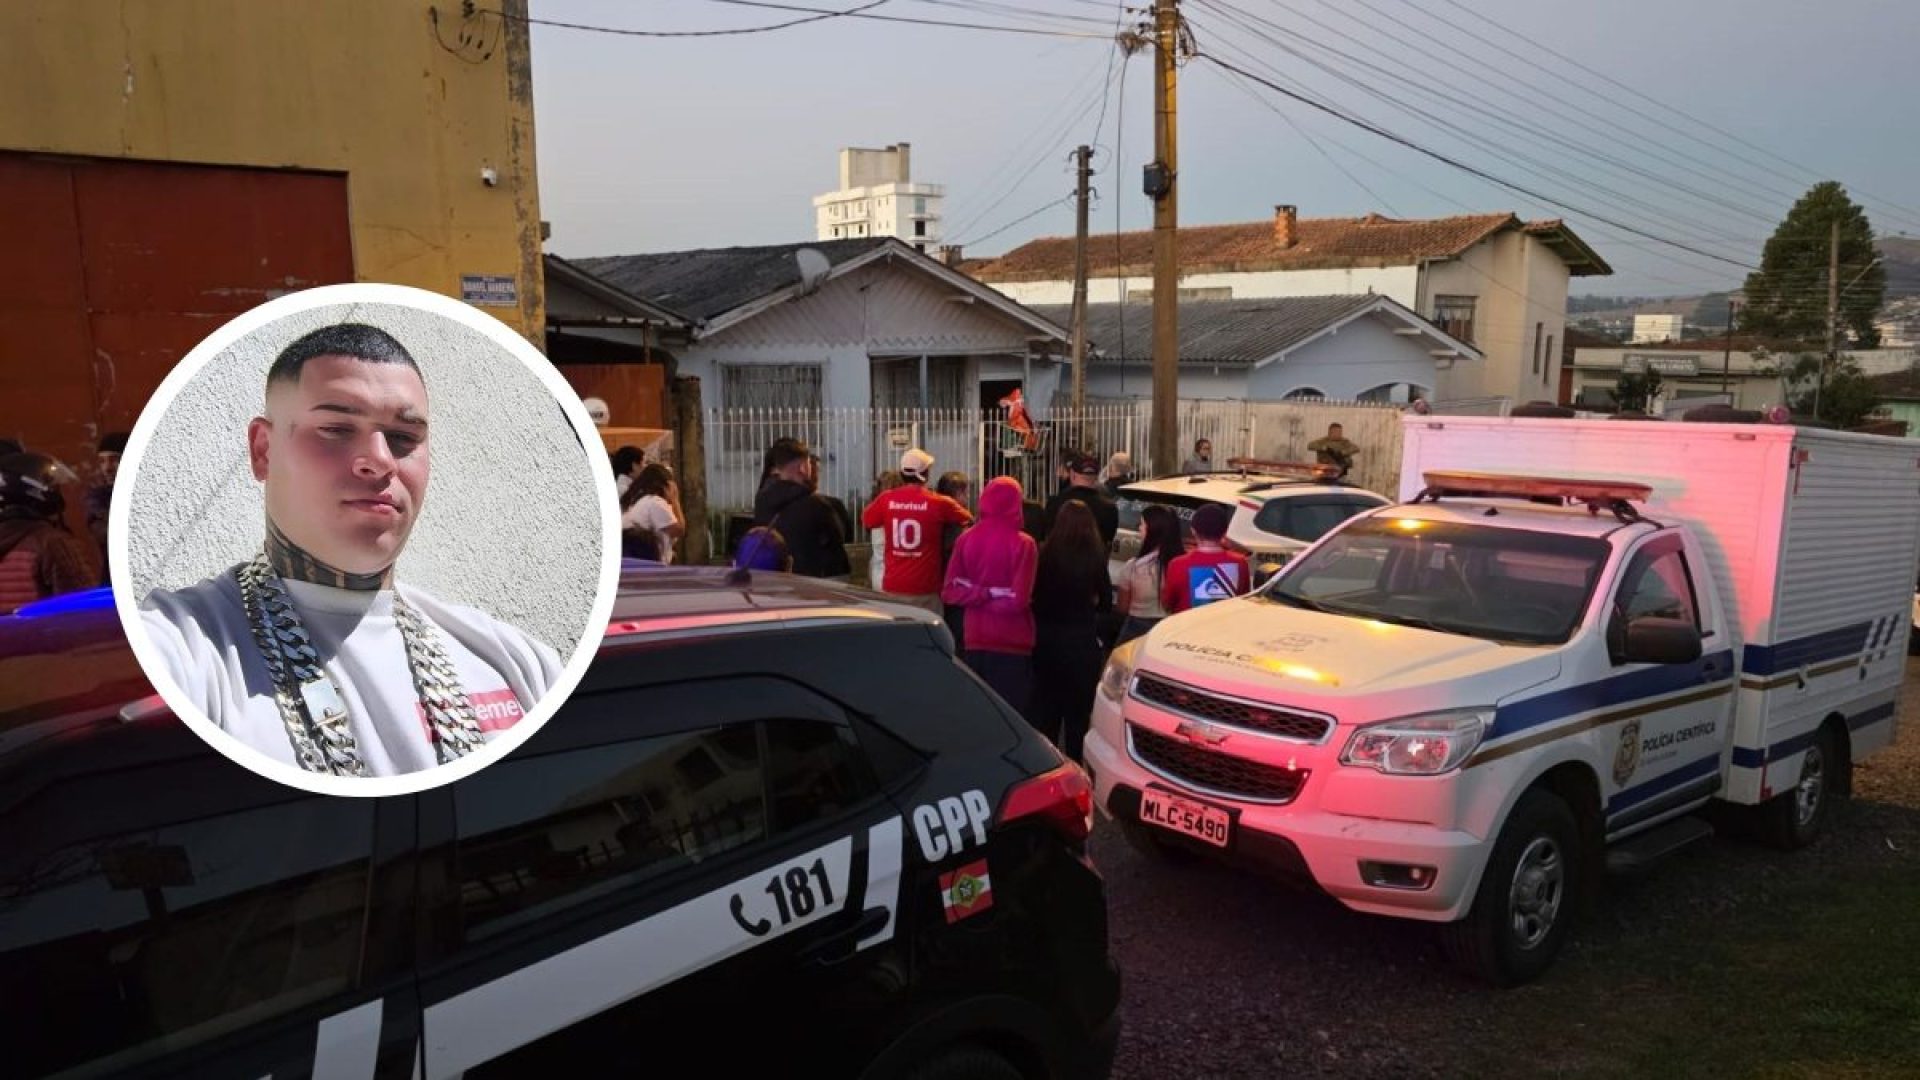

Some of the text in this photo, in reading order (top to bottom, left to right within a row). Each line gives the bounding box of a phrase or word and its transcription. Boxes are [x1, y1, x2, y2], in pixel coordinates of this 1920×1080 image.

[893, 518, 921, 549] 10
[913, 789, 991, 862] CPP
[765, 857, 833, 926] 181
